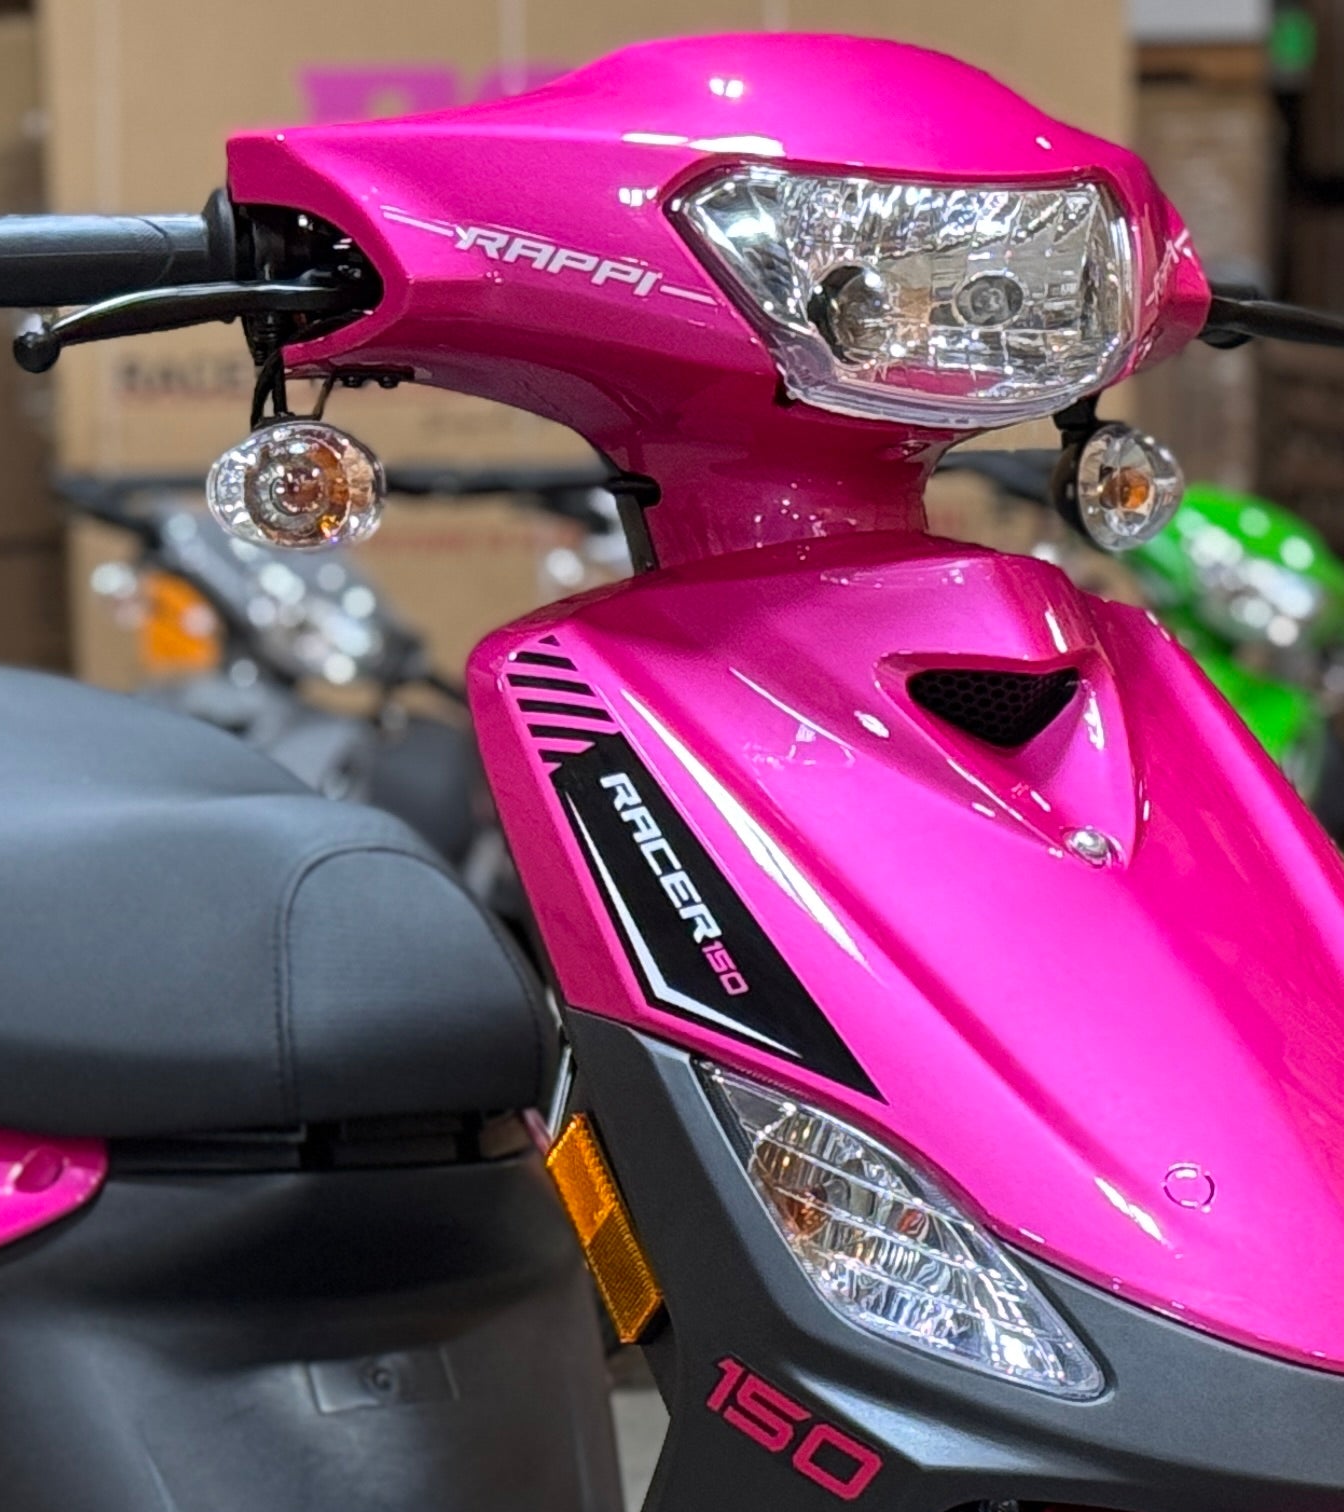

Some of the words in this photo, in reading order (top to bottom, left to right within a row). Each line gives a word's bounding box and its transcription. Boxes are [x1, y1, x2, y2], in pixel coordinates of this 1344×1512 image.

[455, 226, 662, 297] RAPPI
[599, 772, 723, 944] RACER
[701, 939, 749, 997] 150
[706, 1357, 884, 1501] 150
